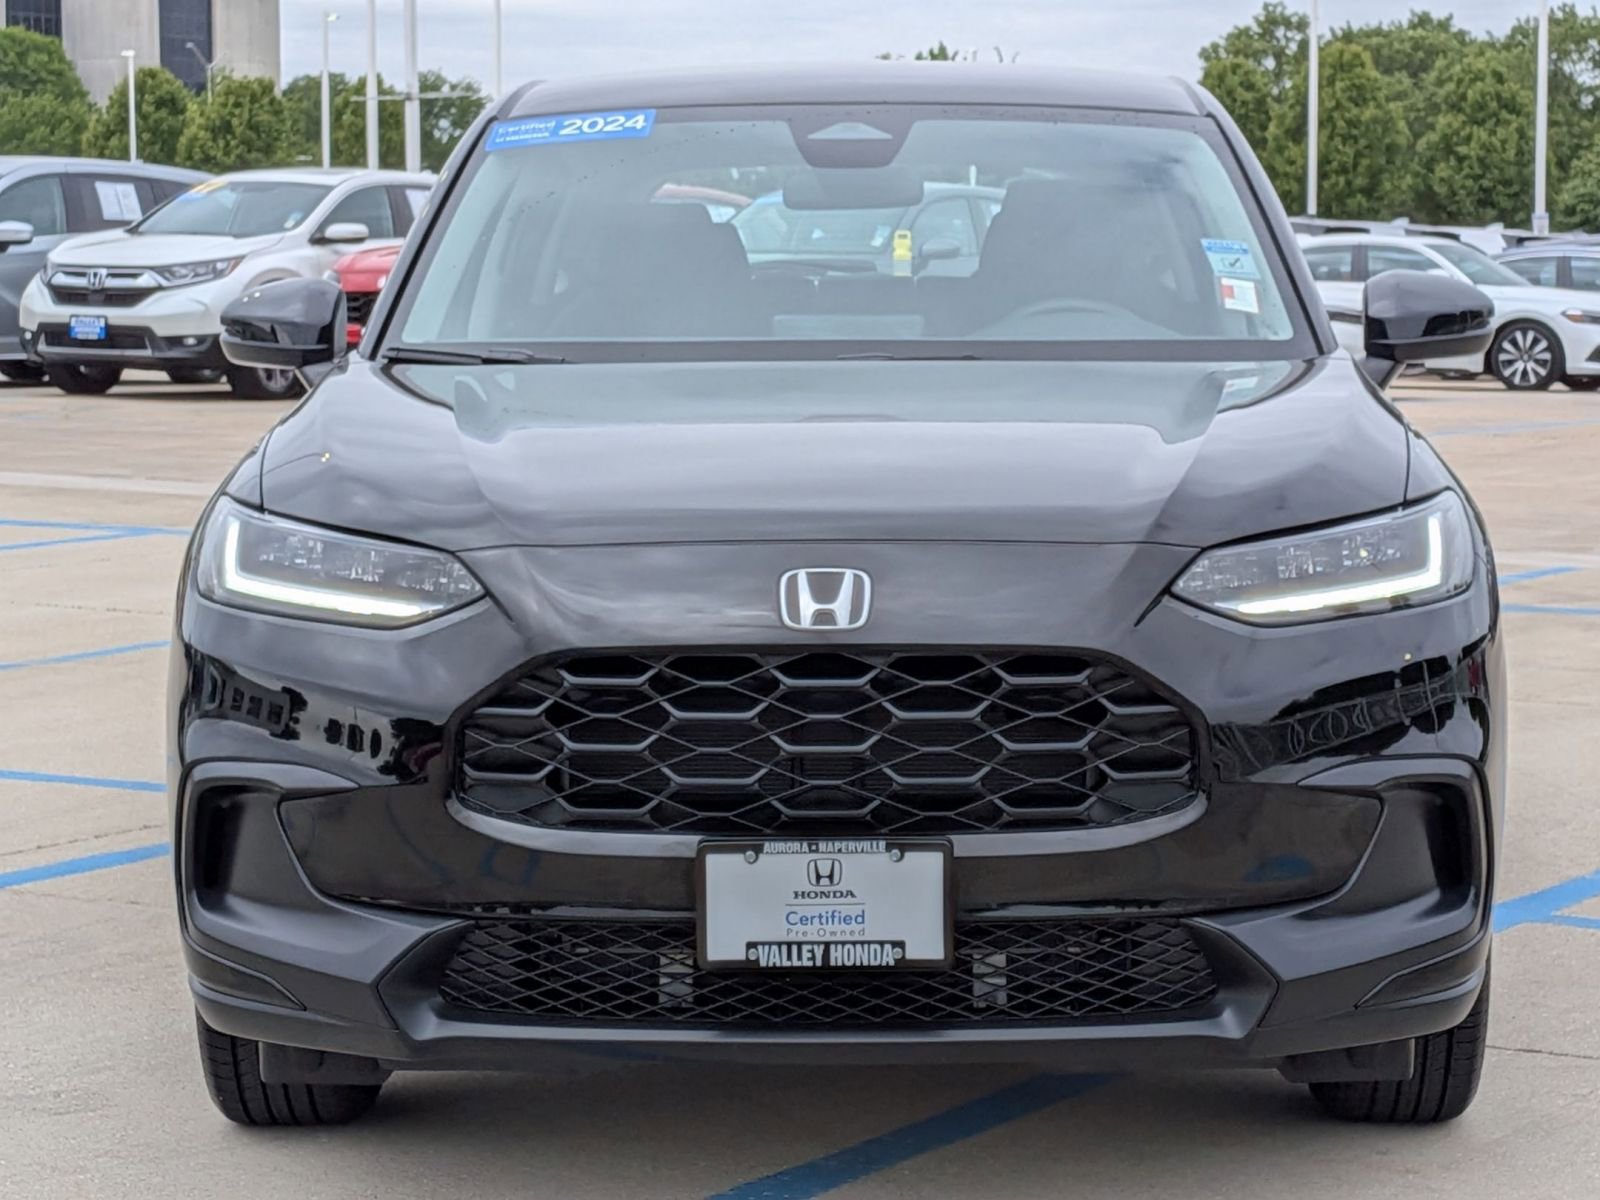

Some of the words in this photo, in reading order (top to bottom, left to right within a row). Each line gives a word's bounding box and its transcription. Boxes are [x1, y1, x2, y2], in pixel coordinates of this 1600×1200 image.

[559, 115, 648, 135] 2024
[763, 841, 809, 854] AURORA
[819, 840, 886, 853] NAPERVILLE
[793, 890, 857, 900] HONDA
[785, 909, 866, 926] Certified
[786, 928, 866, 938] Pre-Owned
[757, 944, 825, 967] VALLEY
[829, 943, 896, 967] HONDA
